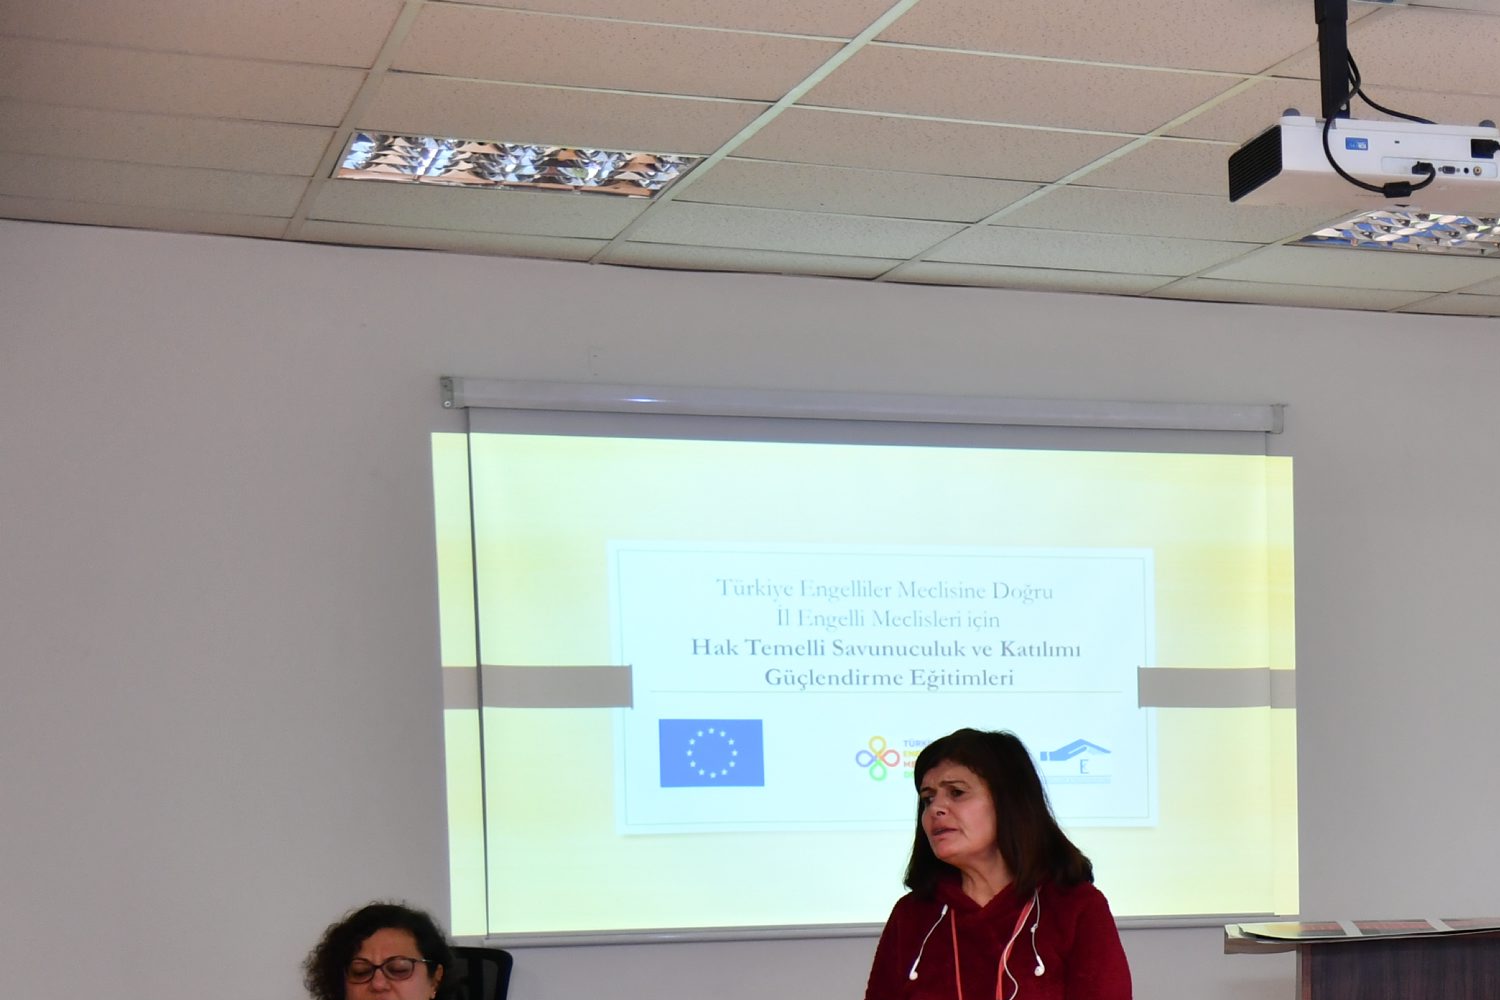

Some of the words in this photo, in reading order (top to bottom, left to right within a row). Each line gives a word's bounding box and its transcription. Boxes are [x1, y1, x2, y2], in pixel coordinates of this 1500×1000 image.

[716, 578, 793, 602] Türkiye
[800, 579, 892, 603] Engelliler
[898, 580, 986, 600] Meclisine
[993, 581, 1053, 605] Doğru
[777, 604, 789, 627] İl
[799, 608, 865, 632] Engelli
[872, 609, 962, 628] Meclisleri
[967, 610, 1000, 632] için
[692, 638, 739, 656] Hak
[744, 638, 826, 656] Temelli
[831, 638, 966, 657] Savunuculuk
[971, 645, 993, 657] ve
[1000, 640, 1081, 657] Katılımı
[764, 668, 904, 691] Güçlendirme
[909, 669, 1014, 692] Eğitimleri
[903, 738, 932, 748] TÜRK
